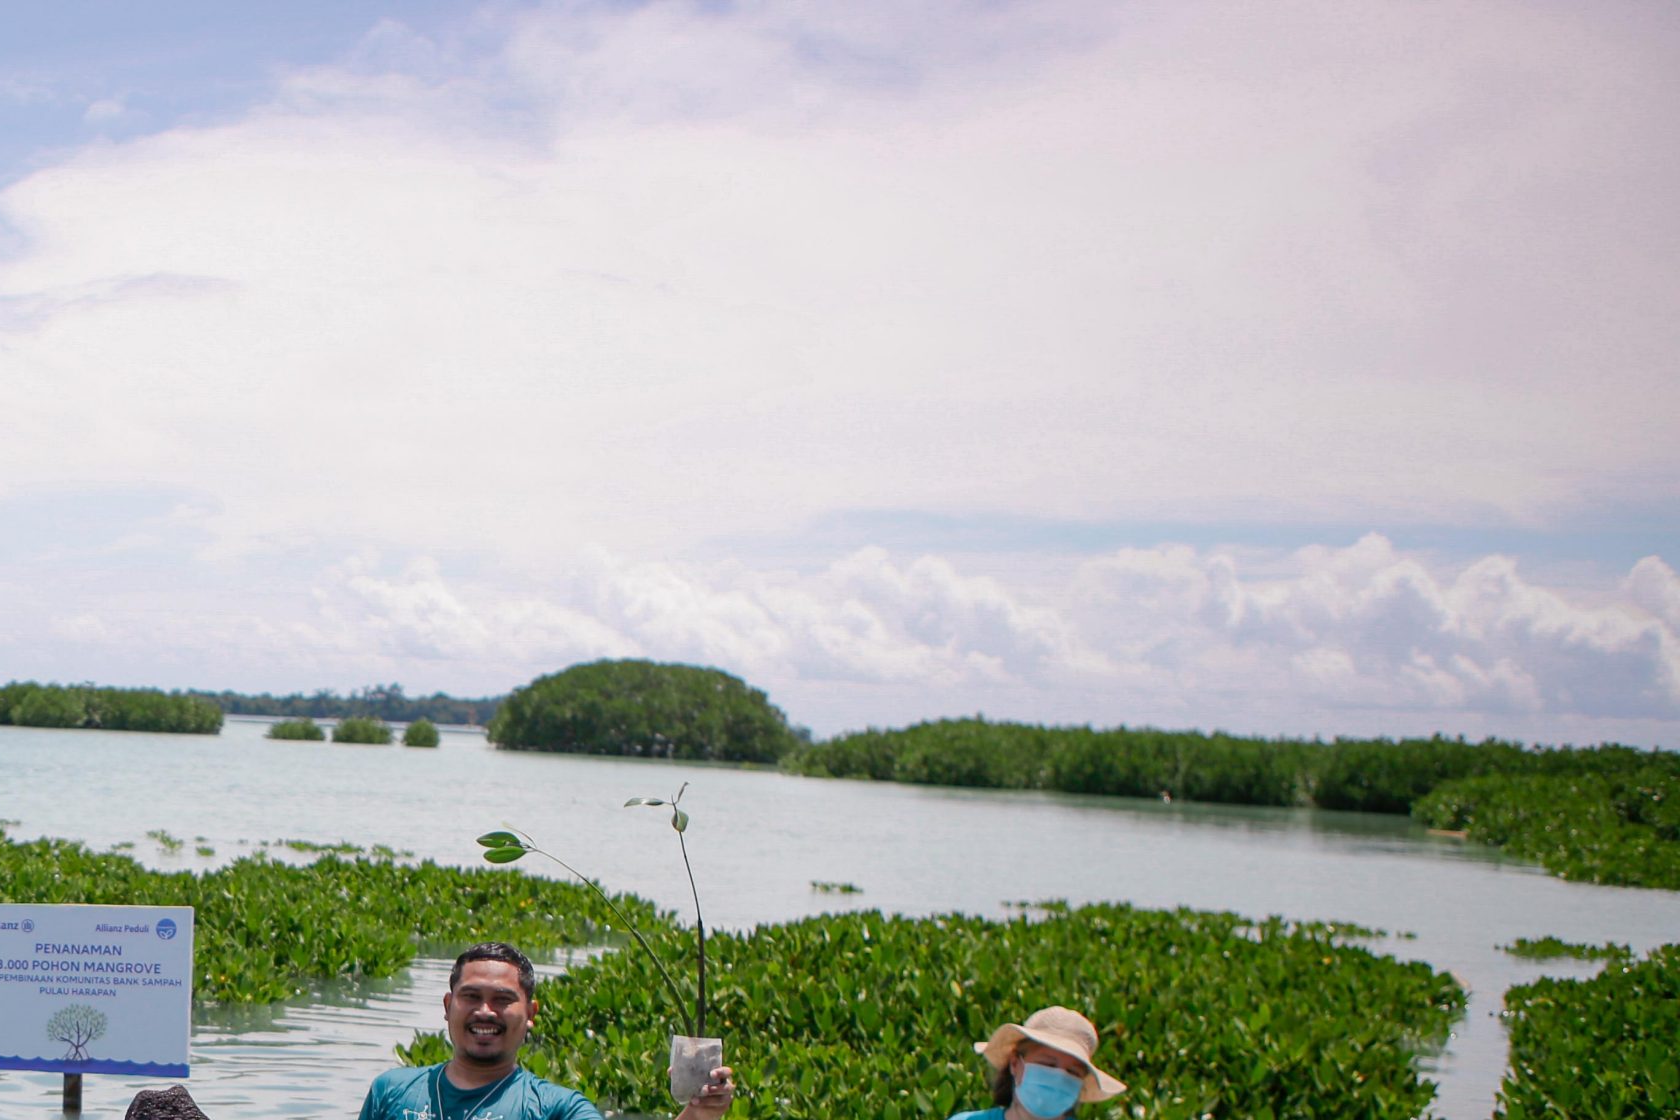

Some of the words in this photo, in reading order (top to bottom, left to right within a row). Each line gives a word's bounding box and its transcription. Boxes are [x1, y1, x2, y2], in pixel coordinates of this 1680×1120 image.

[96, 924, 122, 933] Allianz
[124, 925, 149, 933] Peduli
[35, 943, 122, 956] PENANAMAN
[32, 960, 80, 972] POHON
[83, 962, 162, 974] MANGROVE
[0, 974, 54, 983] PEMBINAAN
[56, 976, 111, 985] KOMUNITAS
[113, 977, 139, 986] BANK
[142, 978, 182, 988] SAMPAH
[39, 986, 69, 995] PULAU
[72, 988, 117, 997] HARAPAN
